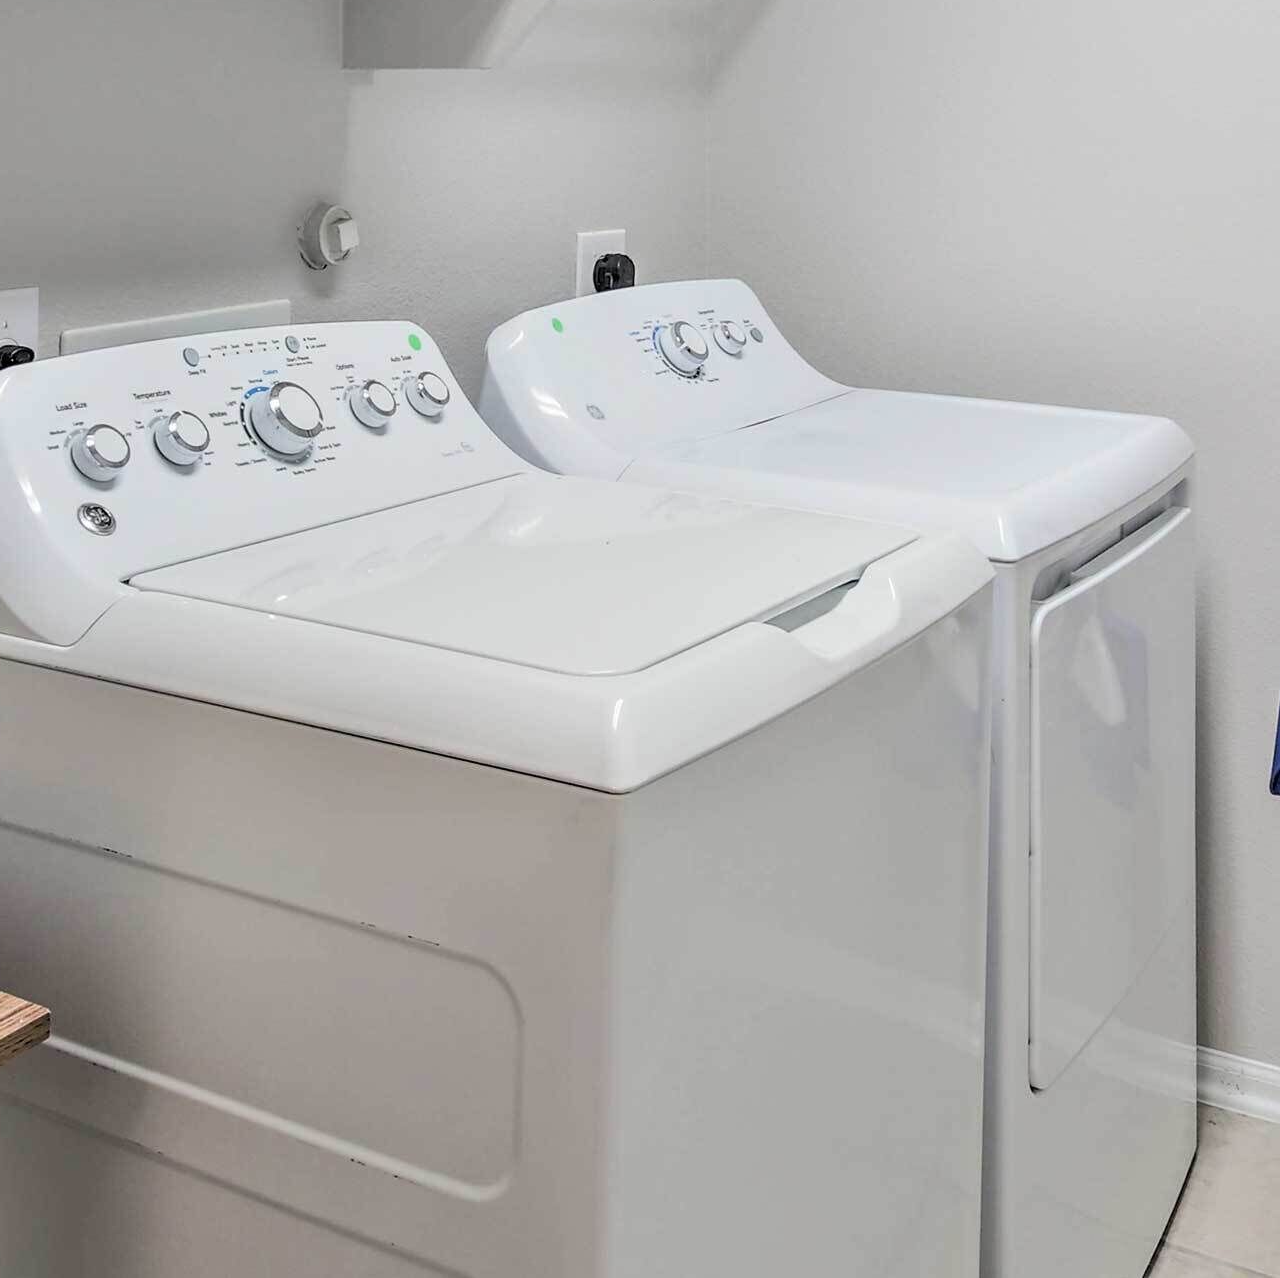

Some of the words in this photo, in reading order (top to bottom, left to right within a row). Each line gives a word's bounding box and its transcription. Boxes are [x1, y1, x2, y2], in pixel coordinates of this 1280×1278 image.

[133, 390, 171, 400] Temperature
[56, 404, 73, 412] Load
[74, 402, 88, 410] Size
